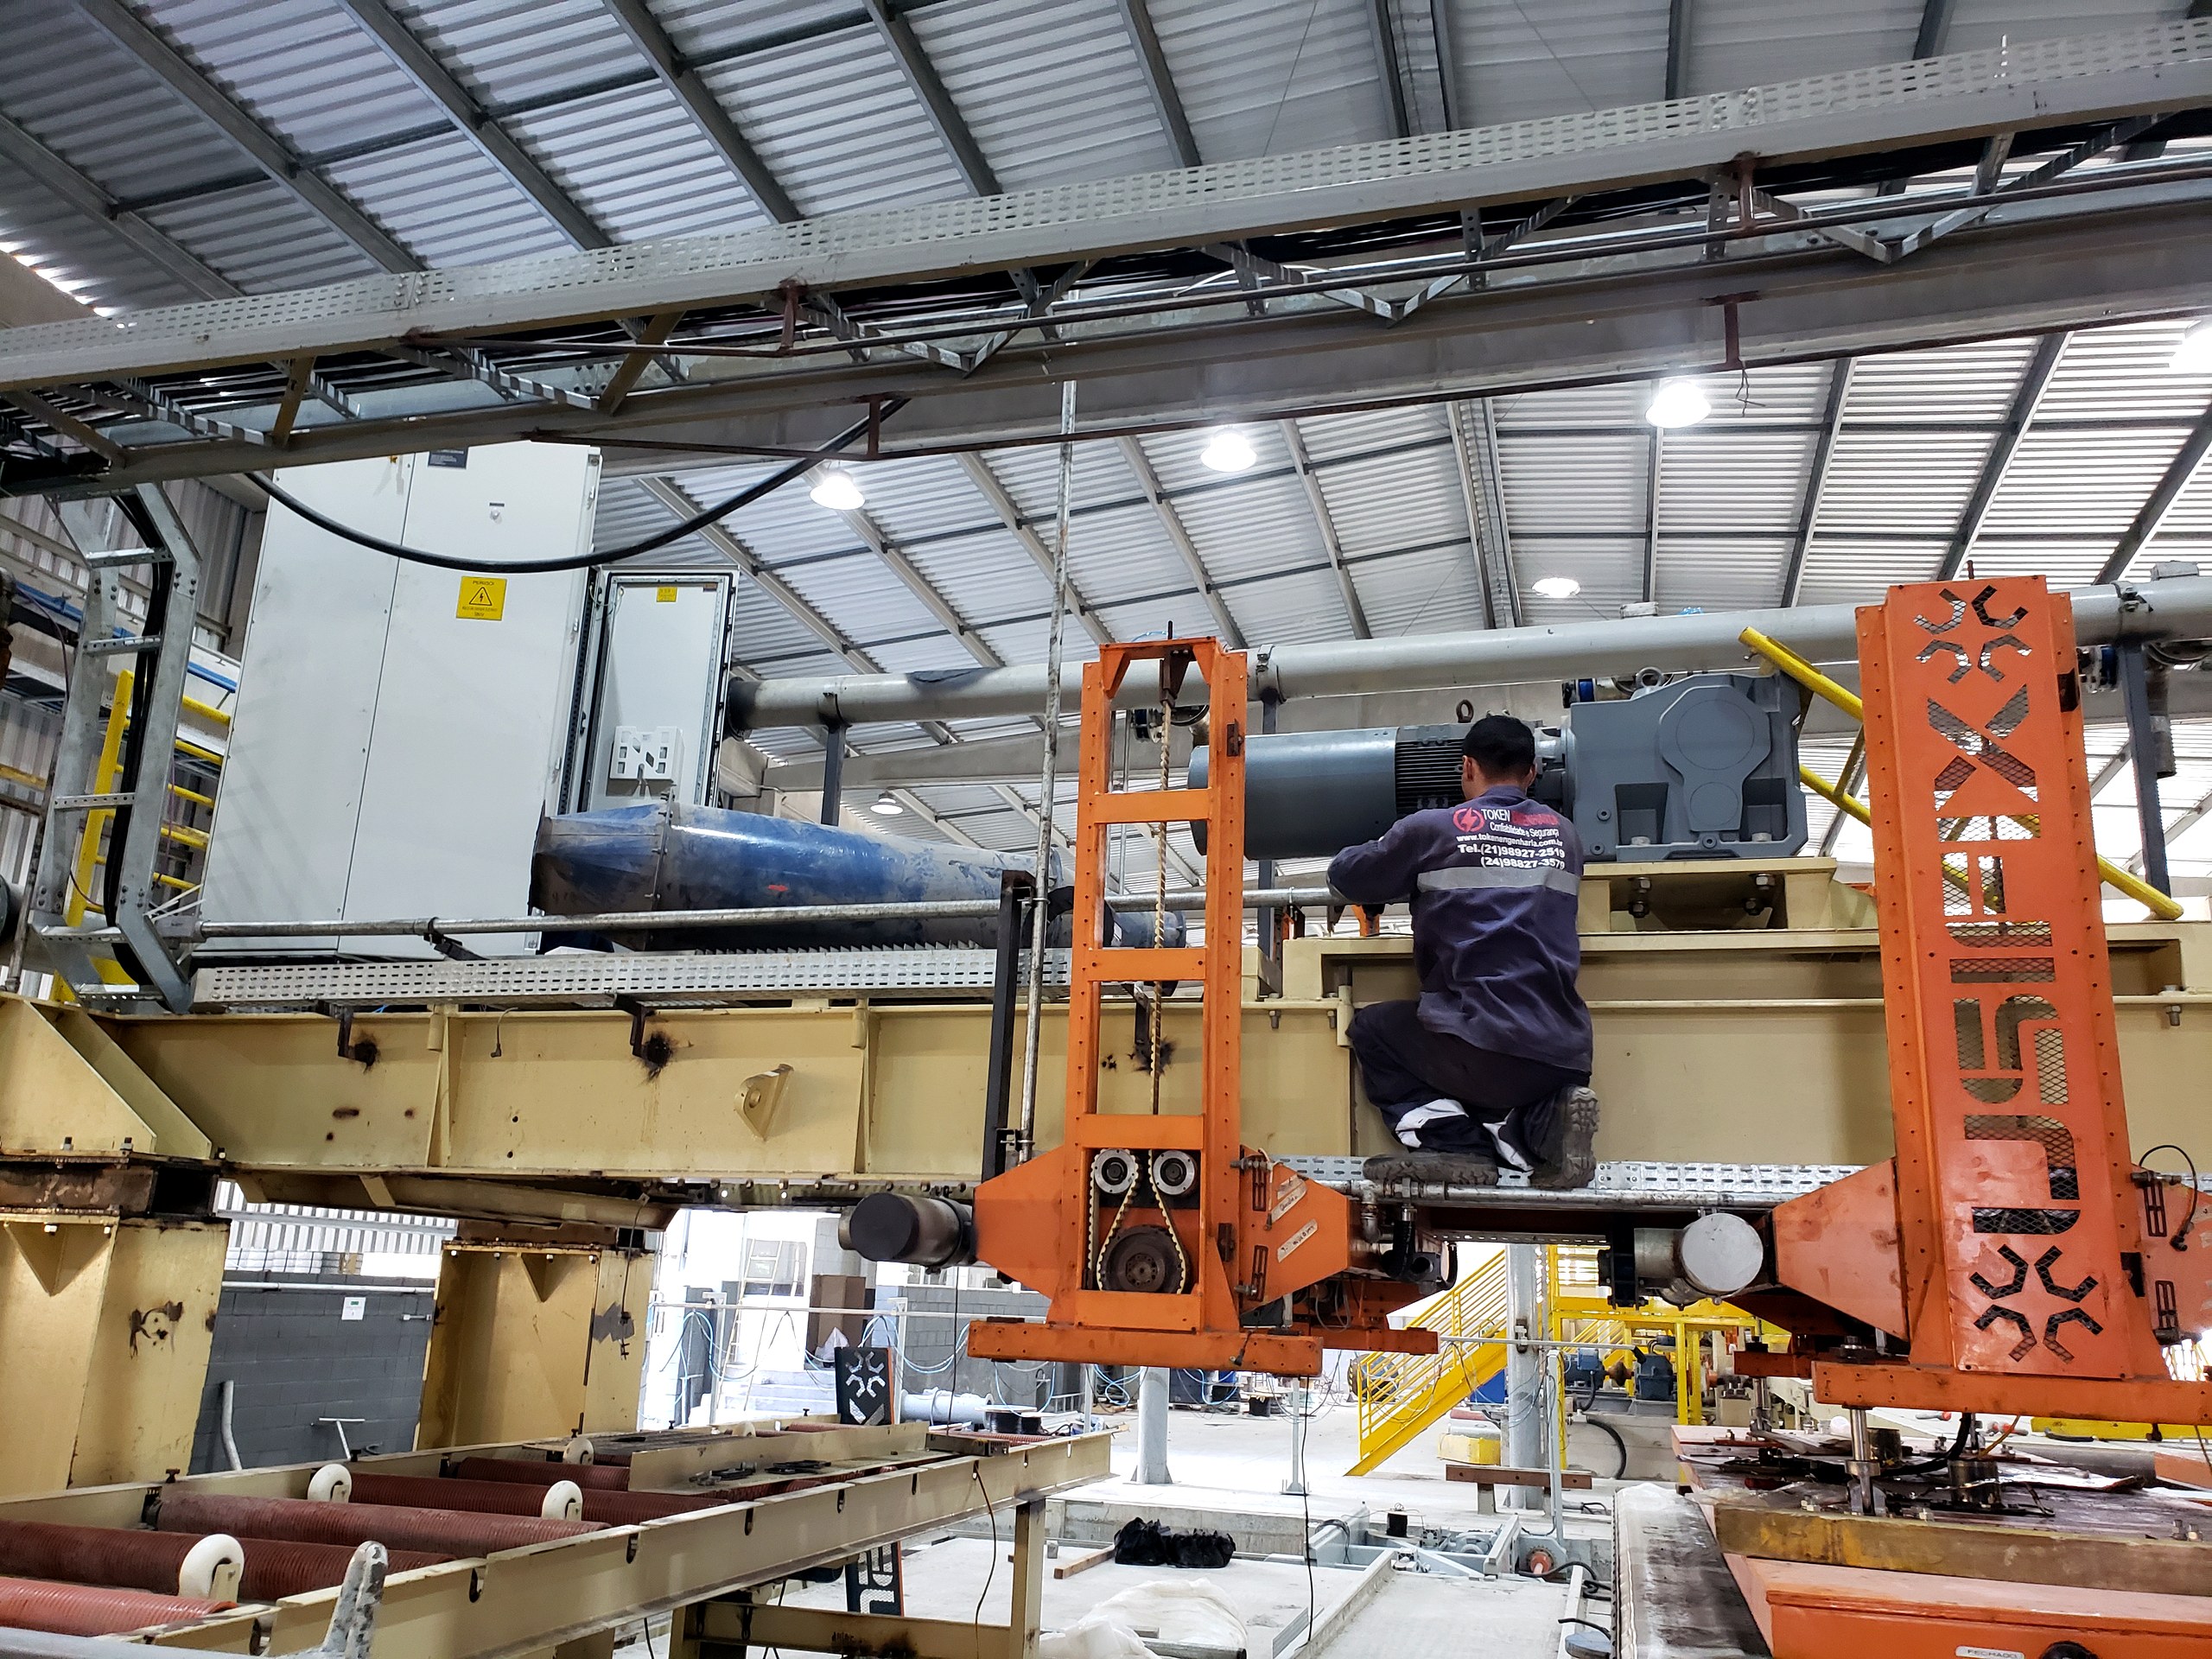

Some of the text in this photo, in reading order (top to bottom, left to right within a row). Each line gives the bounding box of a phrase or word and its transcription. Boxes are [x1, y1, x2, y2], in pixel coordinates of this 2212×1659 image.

[1481, 809, 1510, 822] TOKEN
[1456, 833, 1563, 847] www.tokenengenharia.com.br
[1927, 683, 2081, 1235] USIFIX
